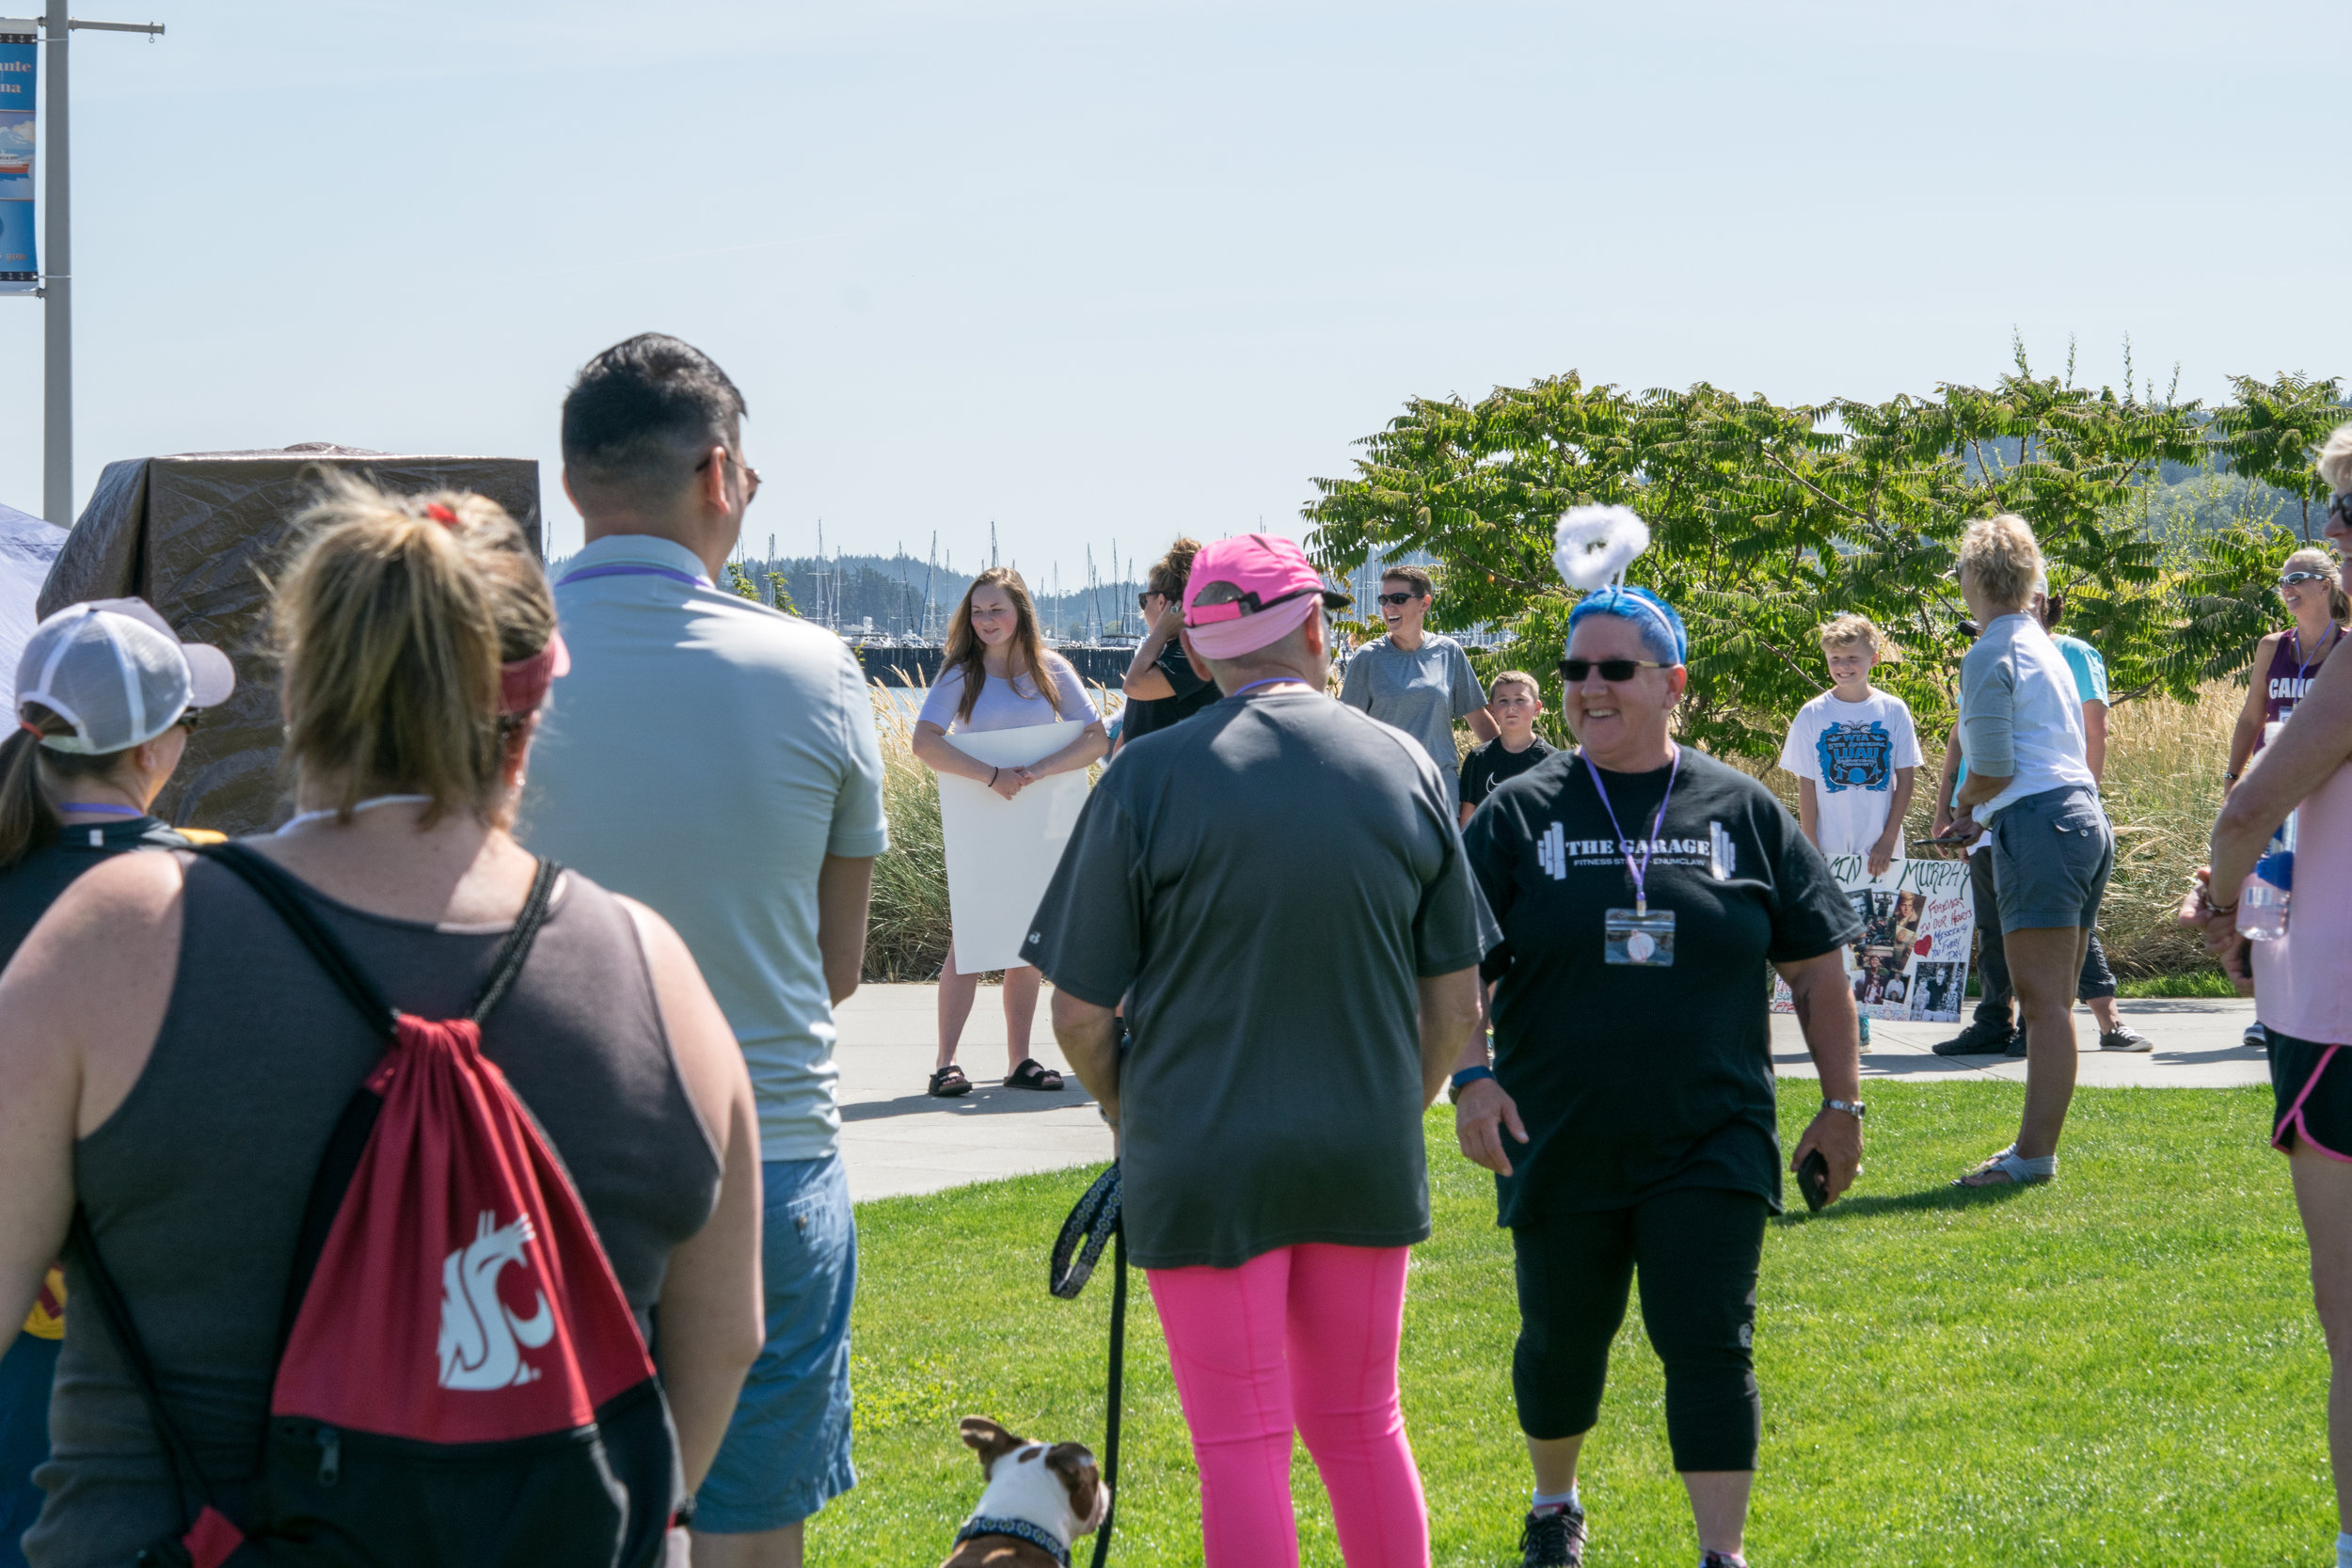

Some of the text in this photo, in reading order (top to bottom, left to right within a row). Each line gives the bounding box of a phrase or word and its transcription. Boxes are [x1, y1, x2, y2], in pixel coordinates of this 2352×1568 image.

[0, 61, 32, 72] nte
[1565, 839, 1710, 857] THE GARAGE
[1573, 857, 1613, 866] FITNESS
[1896, 859, 1971, 900] MURPHY
[1933, 915, 1947, 929] OUR
